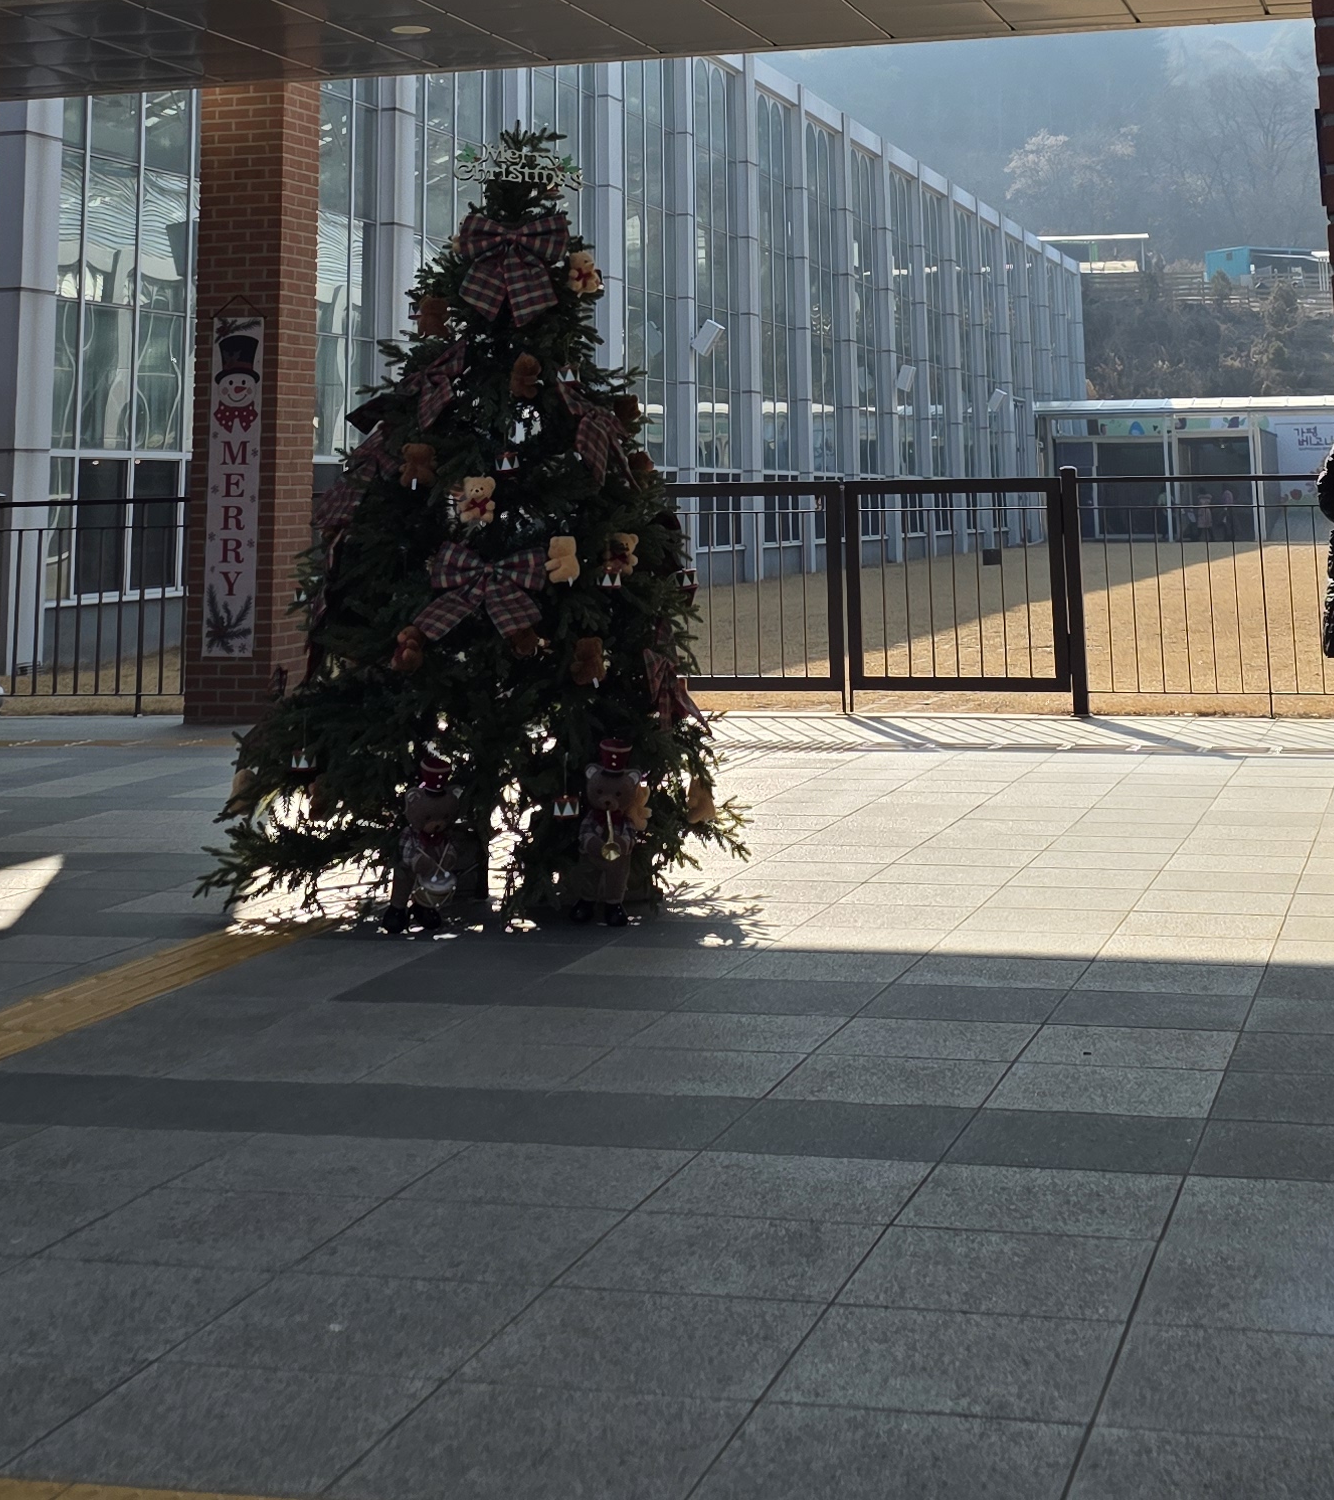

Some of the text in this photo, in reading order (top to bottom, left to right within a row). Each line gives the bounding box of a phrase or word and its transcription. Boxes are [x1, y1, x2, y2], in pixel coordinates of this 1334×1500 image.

[481, 143, 561, 169] Merry
[454, 161, 584, 192] Christmas
[219, 441, 251, 597] MERRY
